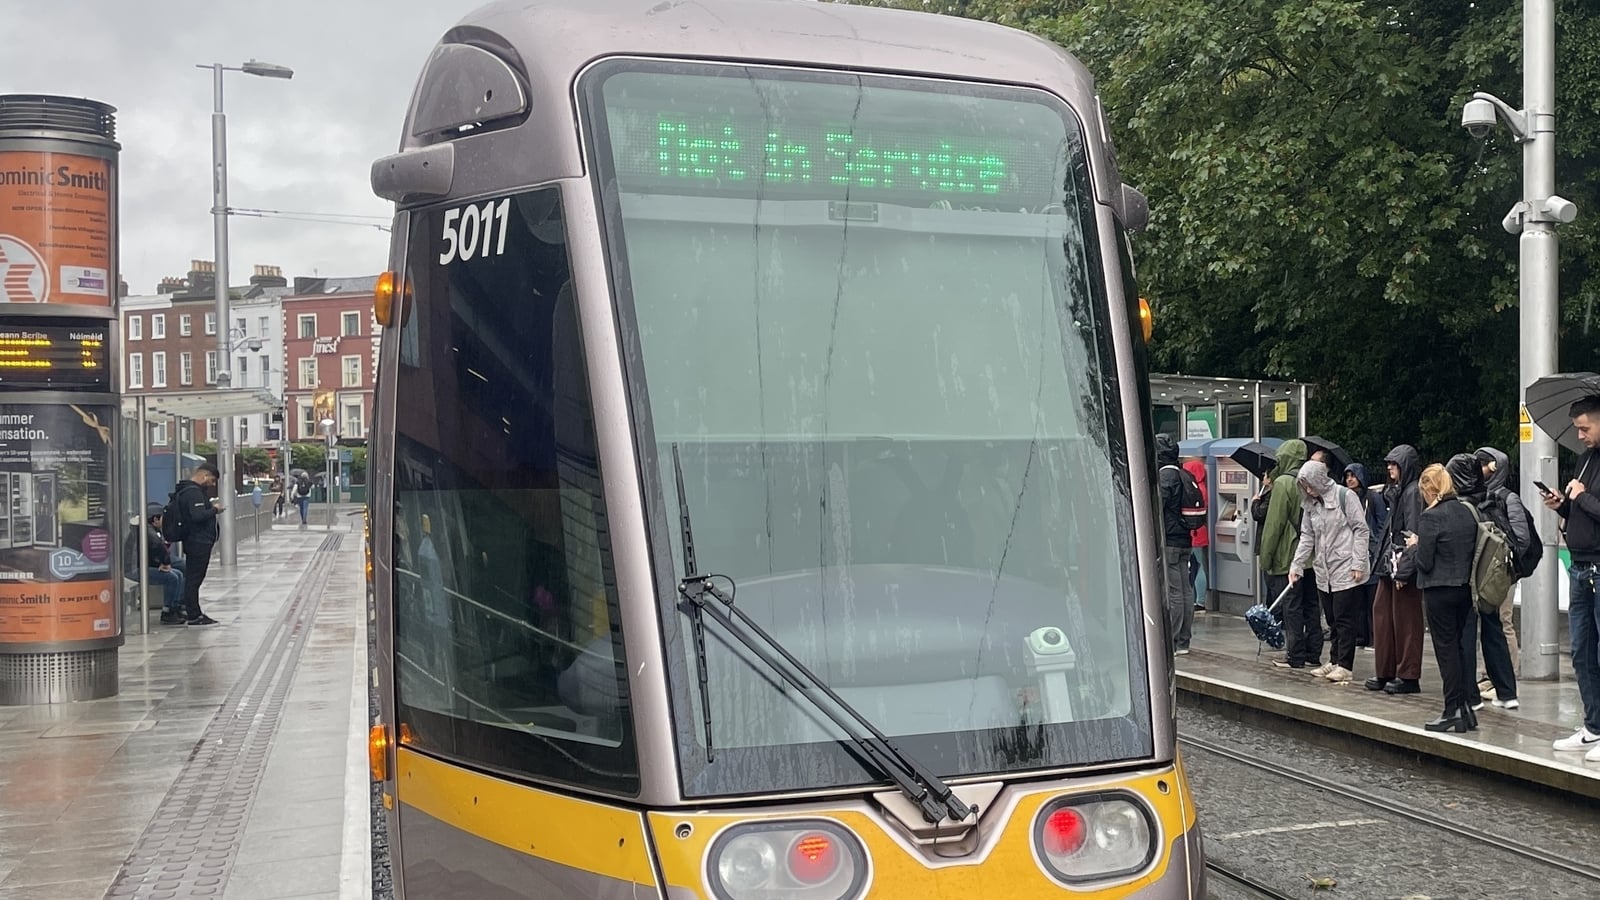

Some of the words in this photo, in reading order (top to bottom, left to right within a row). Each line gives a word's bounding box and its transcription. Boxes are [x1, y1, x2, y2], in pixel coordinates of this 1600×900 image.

[658, 119, 744, 177] Not
[765, 131, 810, 181] in
[825, 131, 1006, 193] Service
[57, 166, 107, 192] Smith
[439, 198, 511, 266] 5011
[58, 555, 72, 567] 10
[20, 593, 51, 604] Smith
